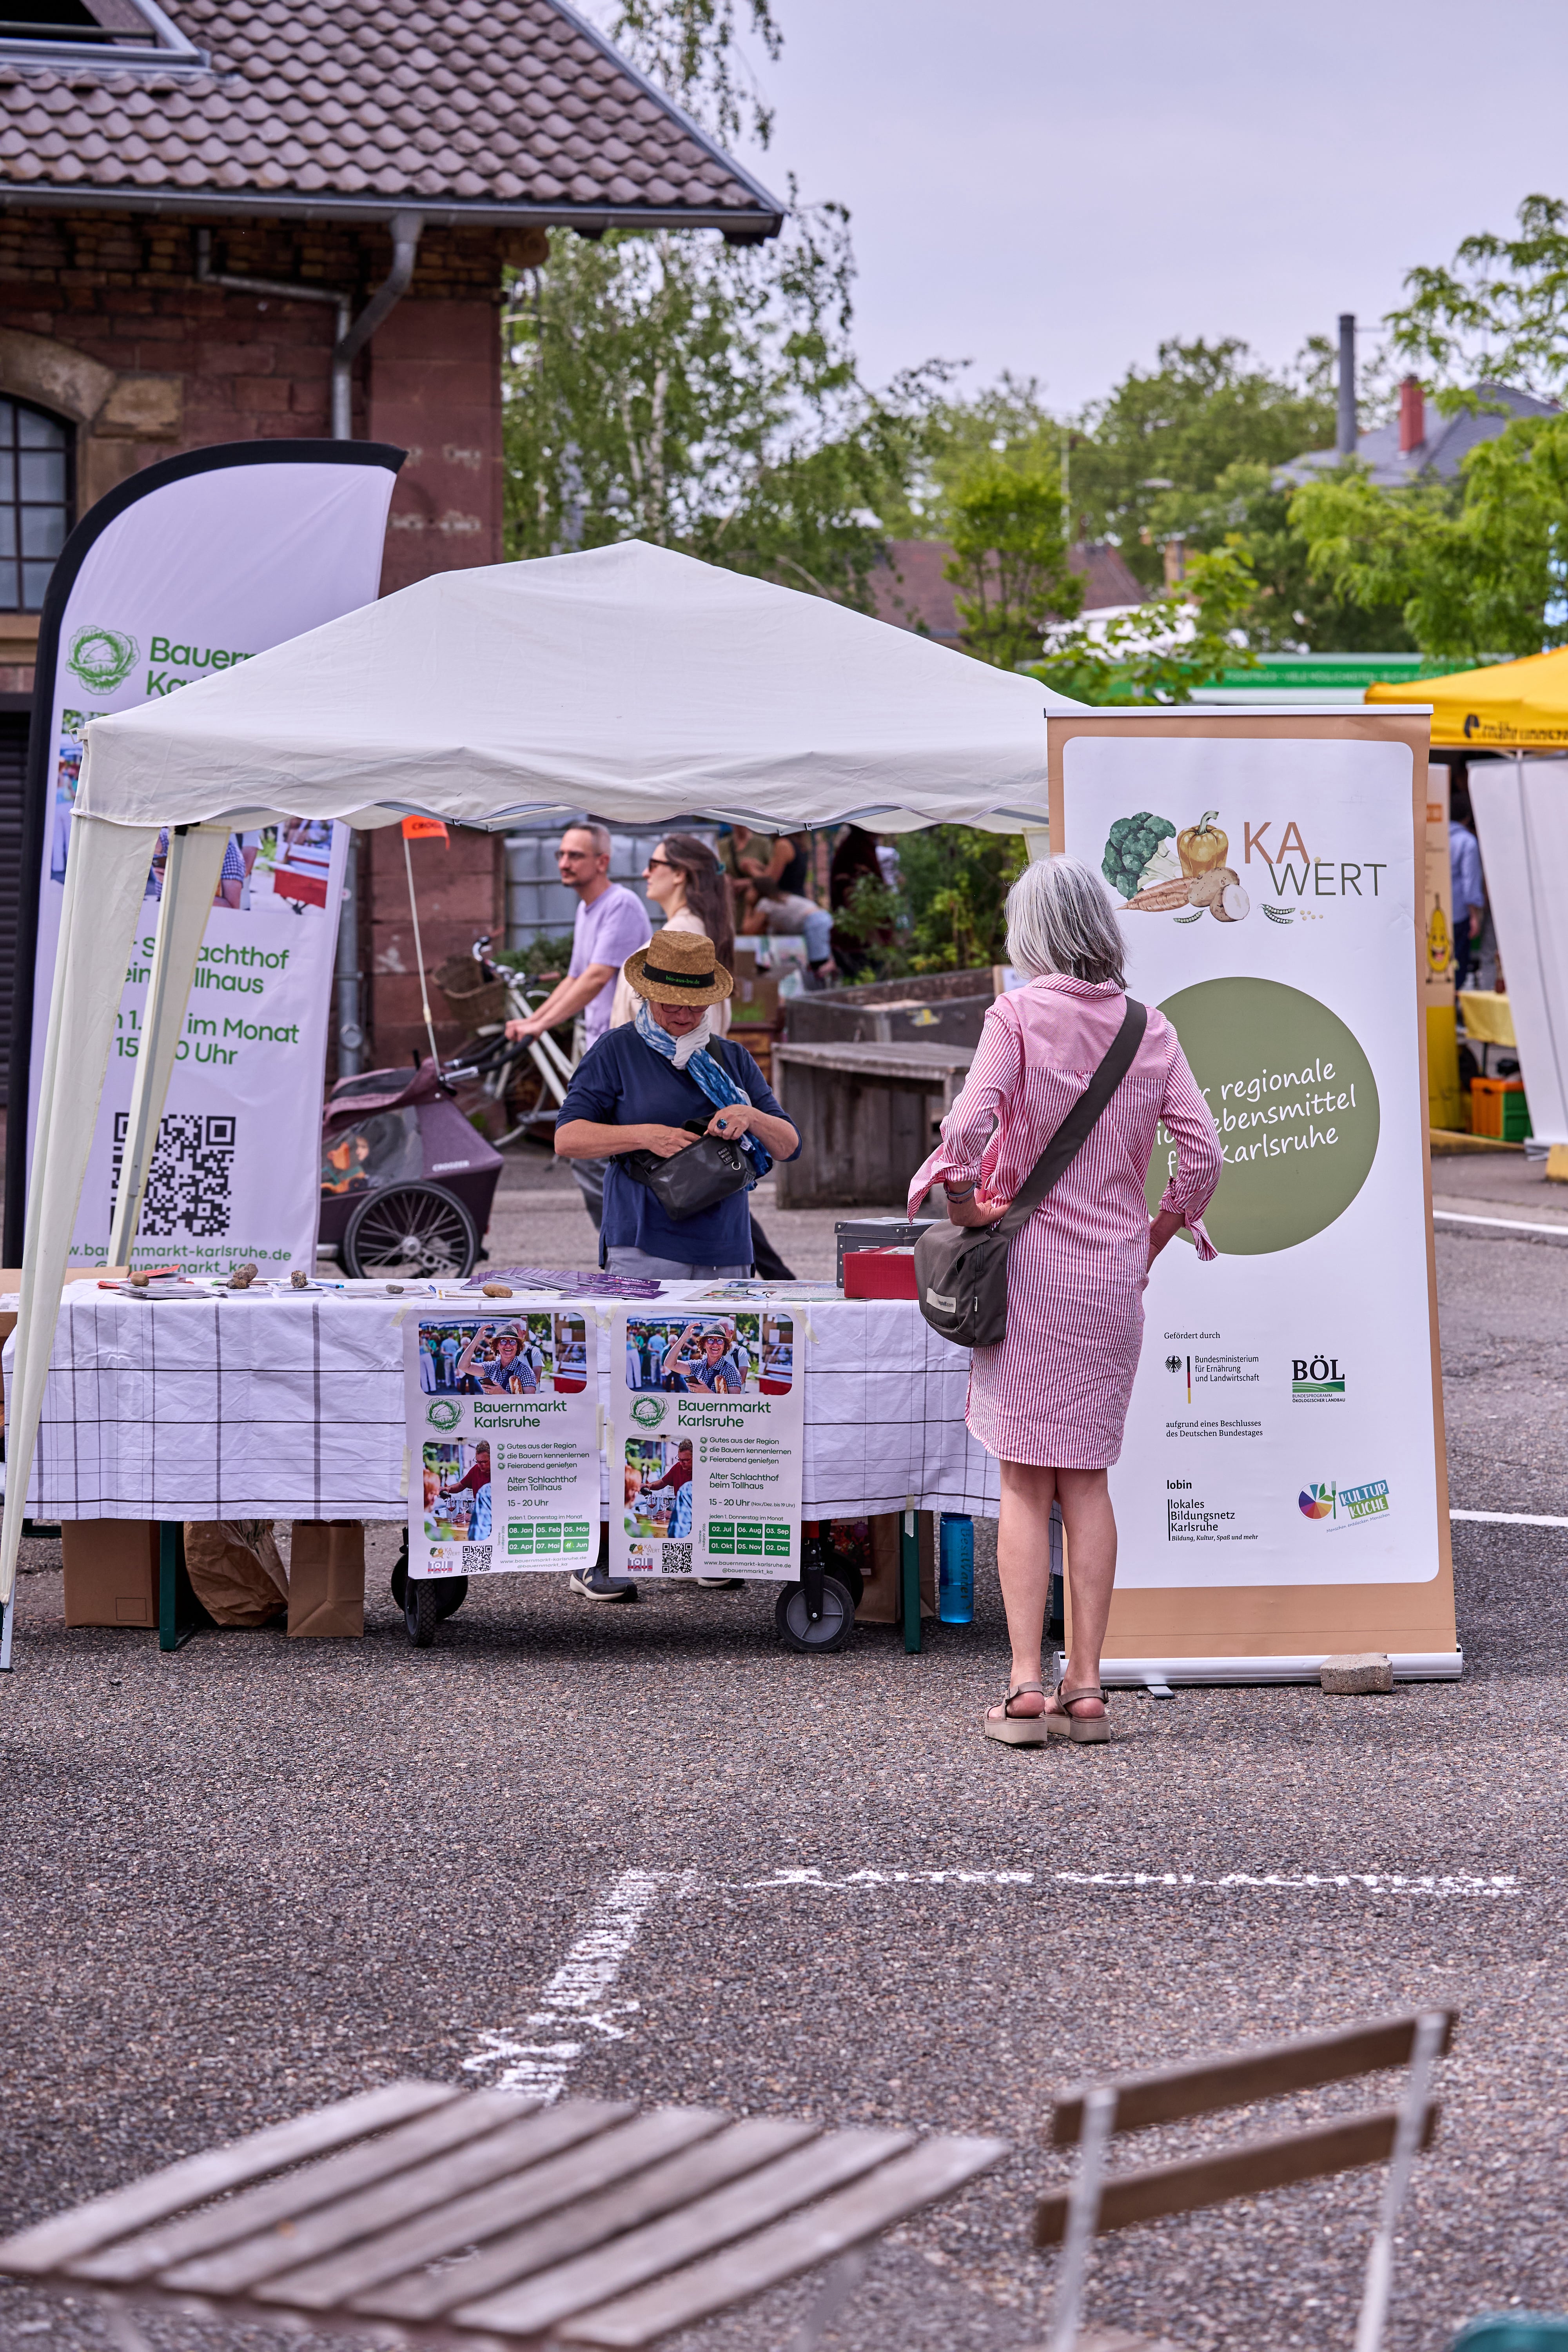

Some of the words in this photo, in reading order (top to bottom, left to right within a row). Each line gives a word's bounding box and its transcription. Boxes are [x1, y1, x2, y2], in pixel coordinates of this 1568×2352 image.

[1244, 822, 1310, 866] KA
[1267, 862, 1387, 896] WERT
[142, 937, 289, 969] Sachthof
[666, 975, 700, 984] bio-aus-bw.de
[129, 1010, 142, 1031] 1.
[187, 1013, 216, 1036] im
[224, 1018, 299, 1044] Monat
[195, 1042, 238, 1065] Uhr
[1222, 1058, 1335, 1102] regionale
[1215, 1083, 1356, 1134] ebensmittel
[1207, 1365, 1241, 1374] Ernährung
[1292, 1355, 1345, 1381] BÖL
[474, 1400, 567, 1413] Bauernmarkt
[679, 1400, 771, 1413] Bauernmarkt
[475, 1416, 540, 1428] Karlsruhe
[679, 1415, 744, 1427] Karlsruhe
[1166, 1421, 1198, 1429] aufgrund
[1167, 1480, 1192, 1489] lobin
[1341, 1482, 1388, 1506] KULTUR
[1171, 1500, 1205, 1510] lokales
[1348, 1498, 1387, 1518] KÜCHE
[1171, 1511, 1235, 1522] Bildungsnetz
[1326, 1524, 1347, 1533] Menschen
[1348, 1519, 1369, 1528] entdecken
[1370, 1513, 1390, 1522] Menschen
[1171, 1522, 1218, 1532] Karlsruhe
